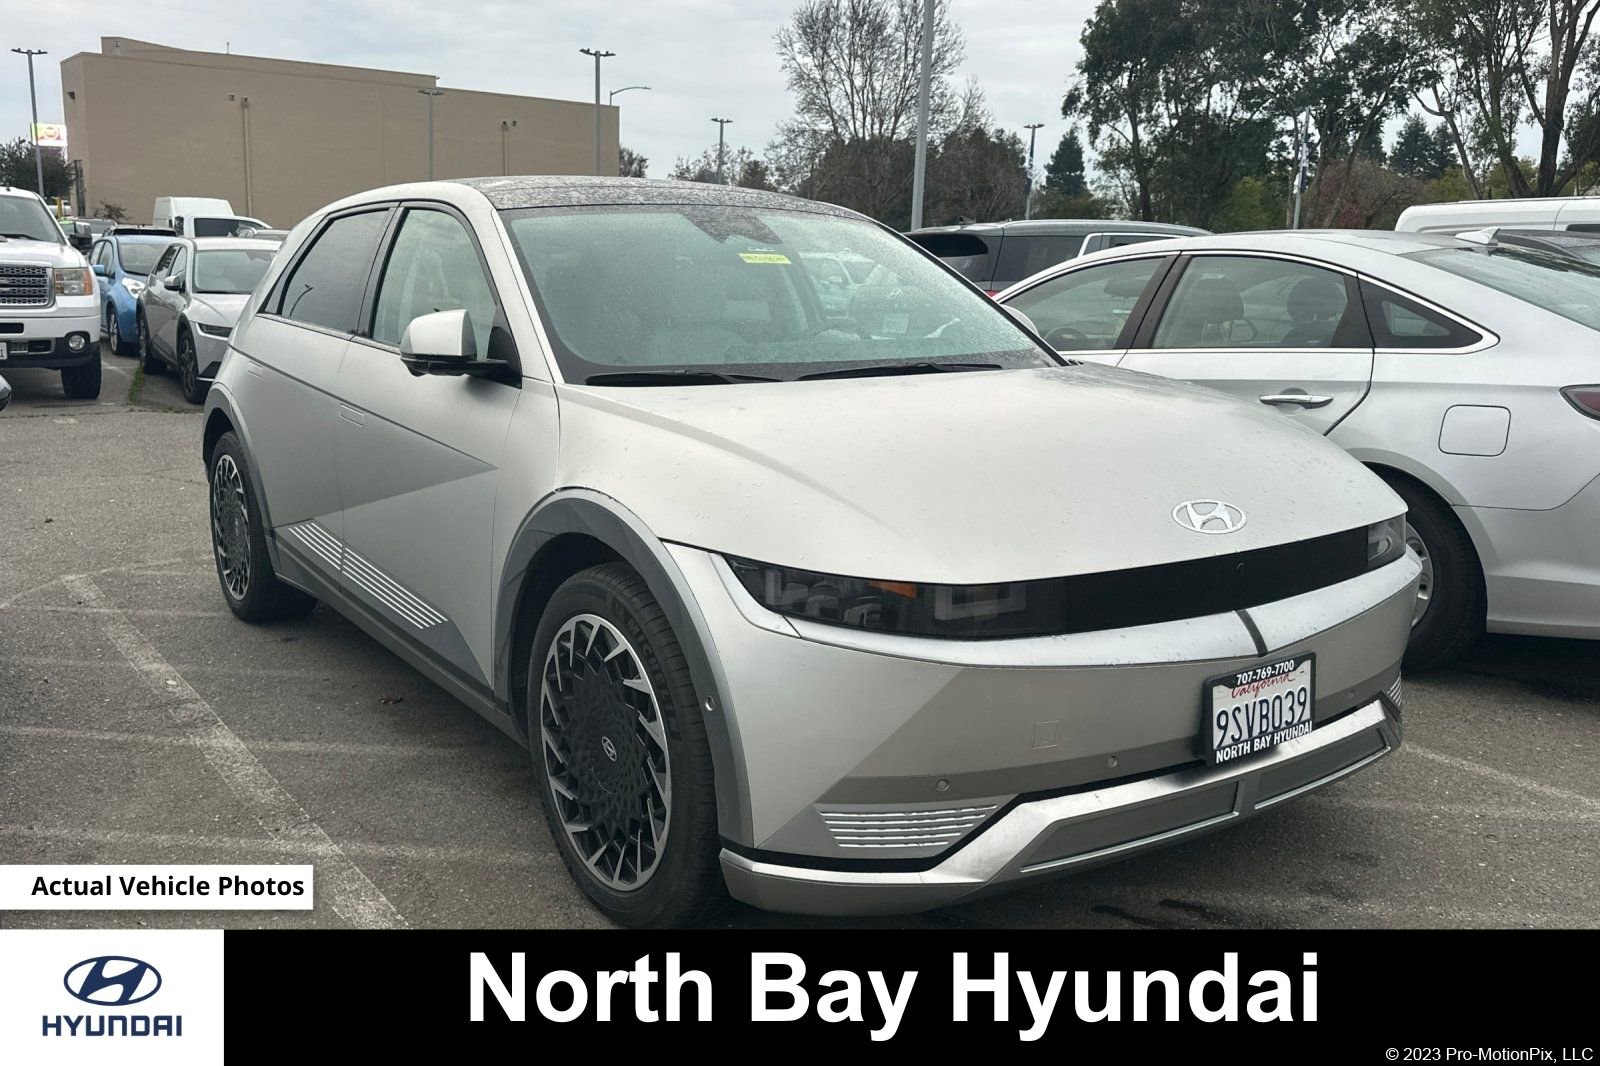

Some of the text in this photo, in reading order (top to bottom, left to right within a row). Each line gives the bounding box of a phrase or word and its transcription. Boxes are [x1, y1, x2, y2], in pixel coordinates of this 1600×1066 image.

[626, 616, 680, 731] MICHELIN
[1231, 673, 1296, 698] California
[1236, 660, 1294, 685] 707-769-7700
[1216, 686, 1307, 749] 9SVB039
[1216, 720, 1313, 764] NORTH BAY HYUNDAI
